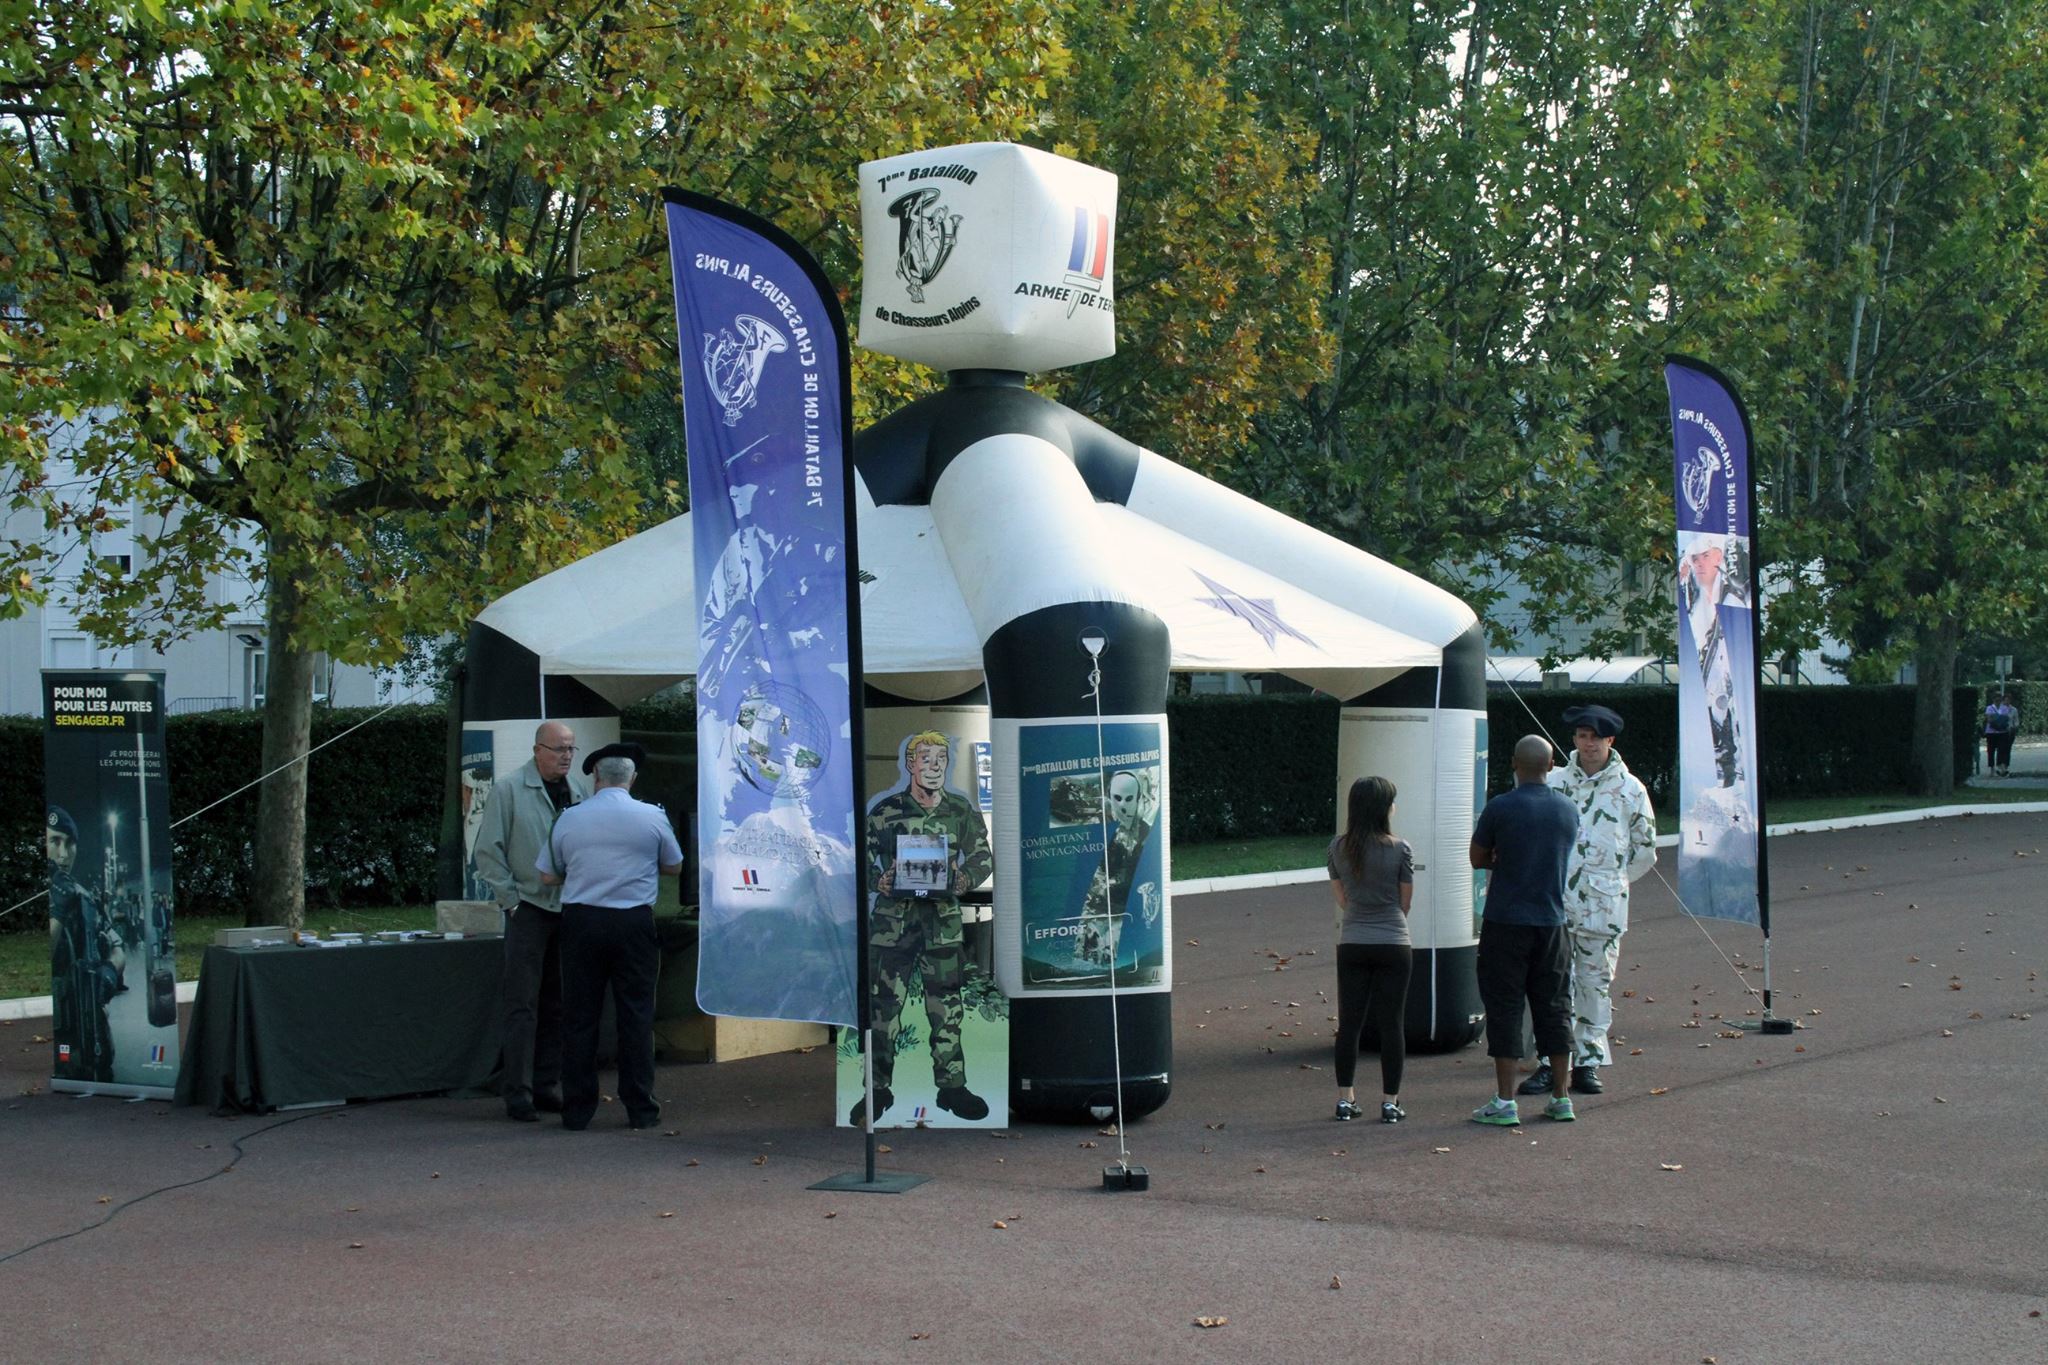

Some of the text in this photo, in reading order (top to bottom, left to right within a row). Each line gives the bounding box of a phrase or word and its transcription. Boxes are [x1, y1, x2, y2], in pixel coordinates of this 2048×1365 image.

[908, 163, 978, 186] Bataillon
[1014, 281, 1071, 302] ARMEE
[1080, 293, 1096, 307] DE
[875, 296, 981, 328] de Chasseurs Alpins
[54, 686, 107, 698] POUR MOI
[54, 700, 153, 713] POUR LES AUTRES
[55, 715, 125, 727] SENGAGER.FR
[99, 759, 113, 767] LES
[1035, 760, 1079, 775] BATAILLON
[1080, 757, 1092, 769] DE
[1093, 752, 1140, 768] CHASSEURS
[1140, 749, 1160, 762] ALPINS
[1020, 831, 1091, 849] COMBATTANT
[1026, 842, 1105, 860] MONTAGNARD
[1034, 924, 1088, 940] EFFORT
